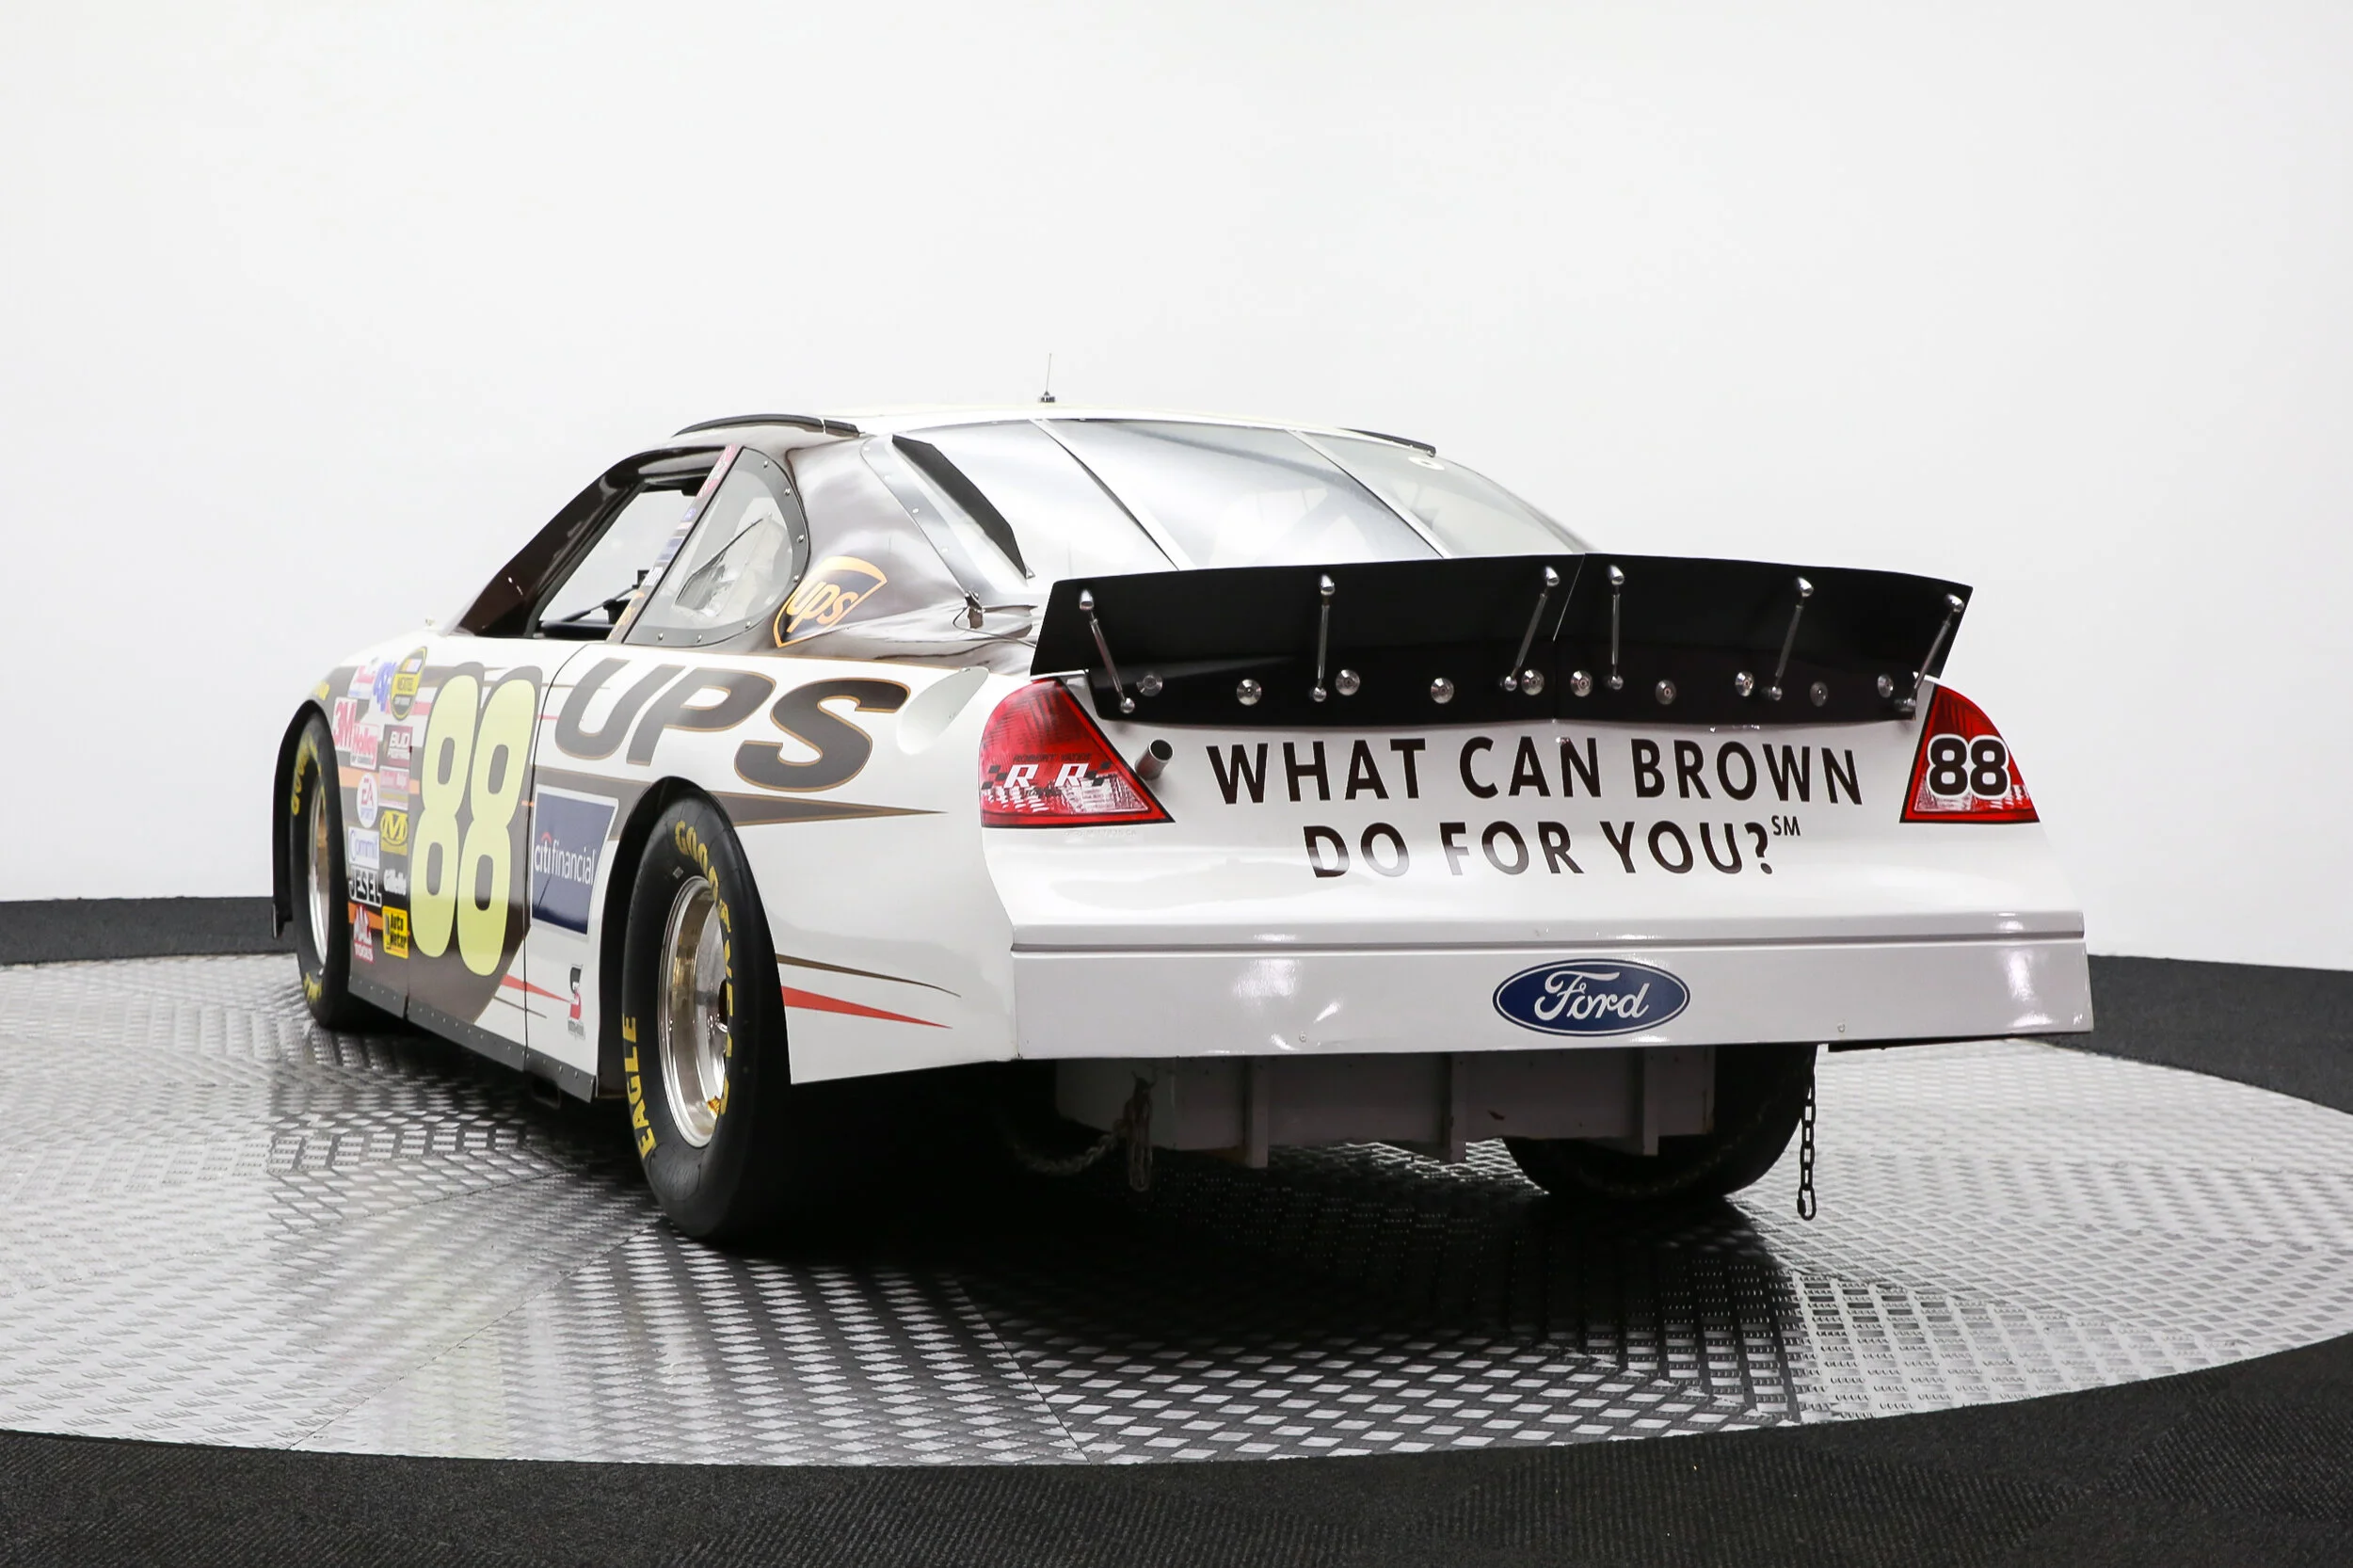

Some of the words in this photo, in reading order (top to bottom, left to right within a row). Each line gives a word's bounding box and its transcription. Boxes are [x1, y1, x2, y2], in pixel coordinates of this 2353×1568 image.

[785, 578, 860, 634] ups
[333, 700, 357, 749] 3M
[389, 730, 410, 748] BUD
[554, 657, 911, 793] UPS
[360, 777, 374, 807] EA
[1206, 739, 1427, 806] WHAT
[1459, 736, 1602, 800] CAN
[1631, 738, 1864, 807] BROWN
[1926, 733, 2011, 800] 88
[410, 666, 540, 977] 88
[1303, 822, 1411, 879] DO
[1439, 820, 1585, 876] FOR
[1600, 820, 1773, 875] YOU?
[1772, 815, 1801, 838] SM
[1533, 969, 1650, 1021] Ford
[622, 1013, 657, 1159] EAGLE
